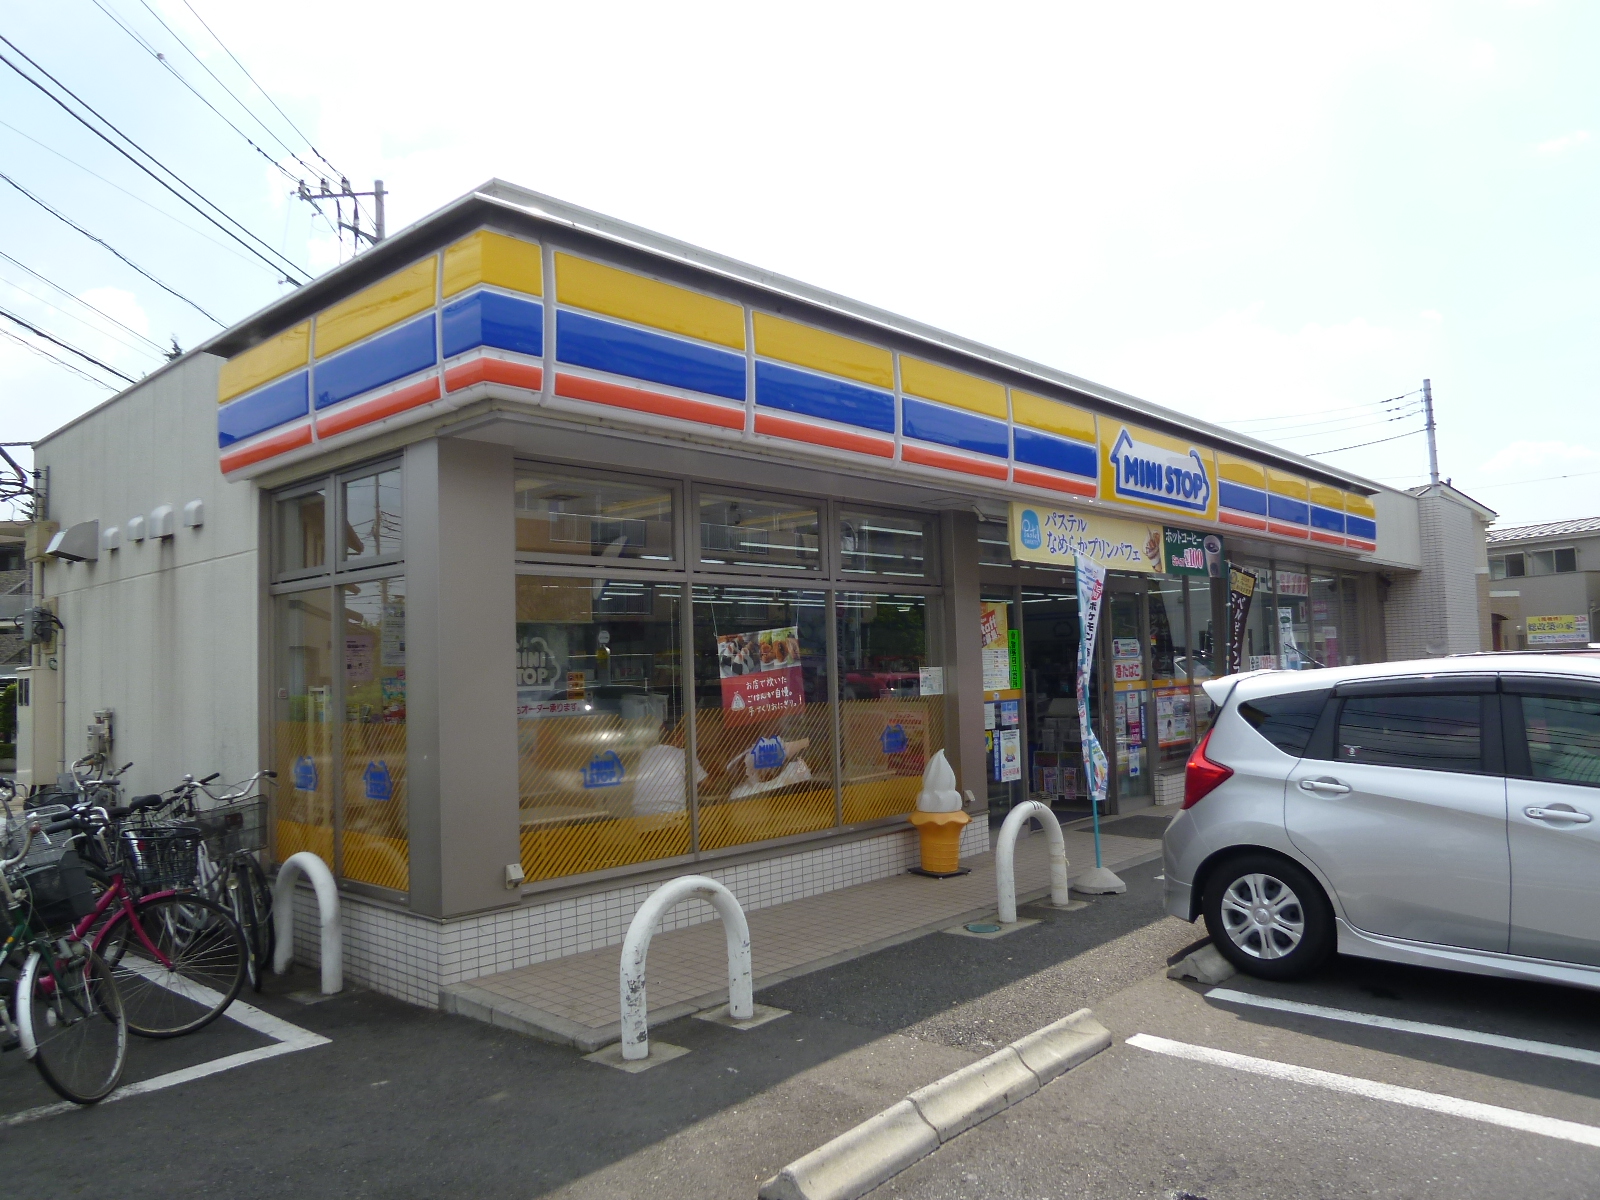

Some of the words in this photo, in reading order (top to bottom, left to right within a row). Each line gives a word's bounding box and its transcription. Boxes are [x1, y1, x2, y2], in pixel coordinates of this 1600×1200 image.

[1124, 454, 1163, 491] MINI
[1165, 465, 1203, 500] STOP
[1044, 512, 1087, 532] パステル
[1165, 528, 1202, 545] ホットコーヒー
[1046, 531, 1141, 561] なめらかプリンパフェ
[1115, 664, 1140, 679] 酒たばこ
[745, 676, 787, 690] お店で炊いた
[747, 686, 793, 703] ごはんが自慢。
